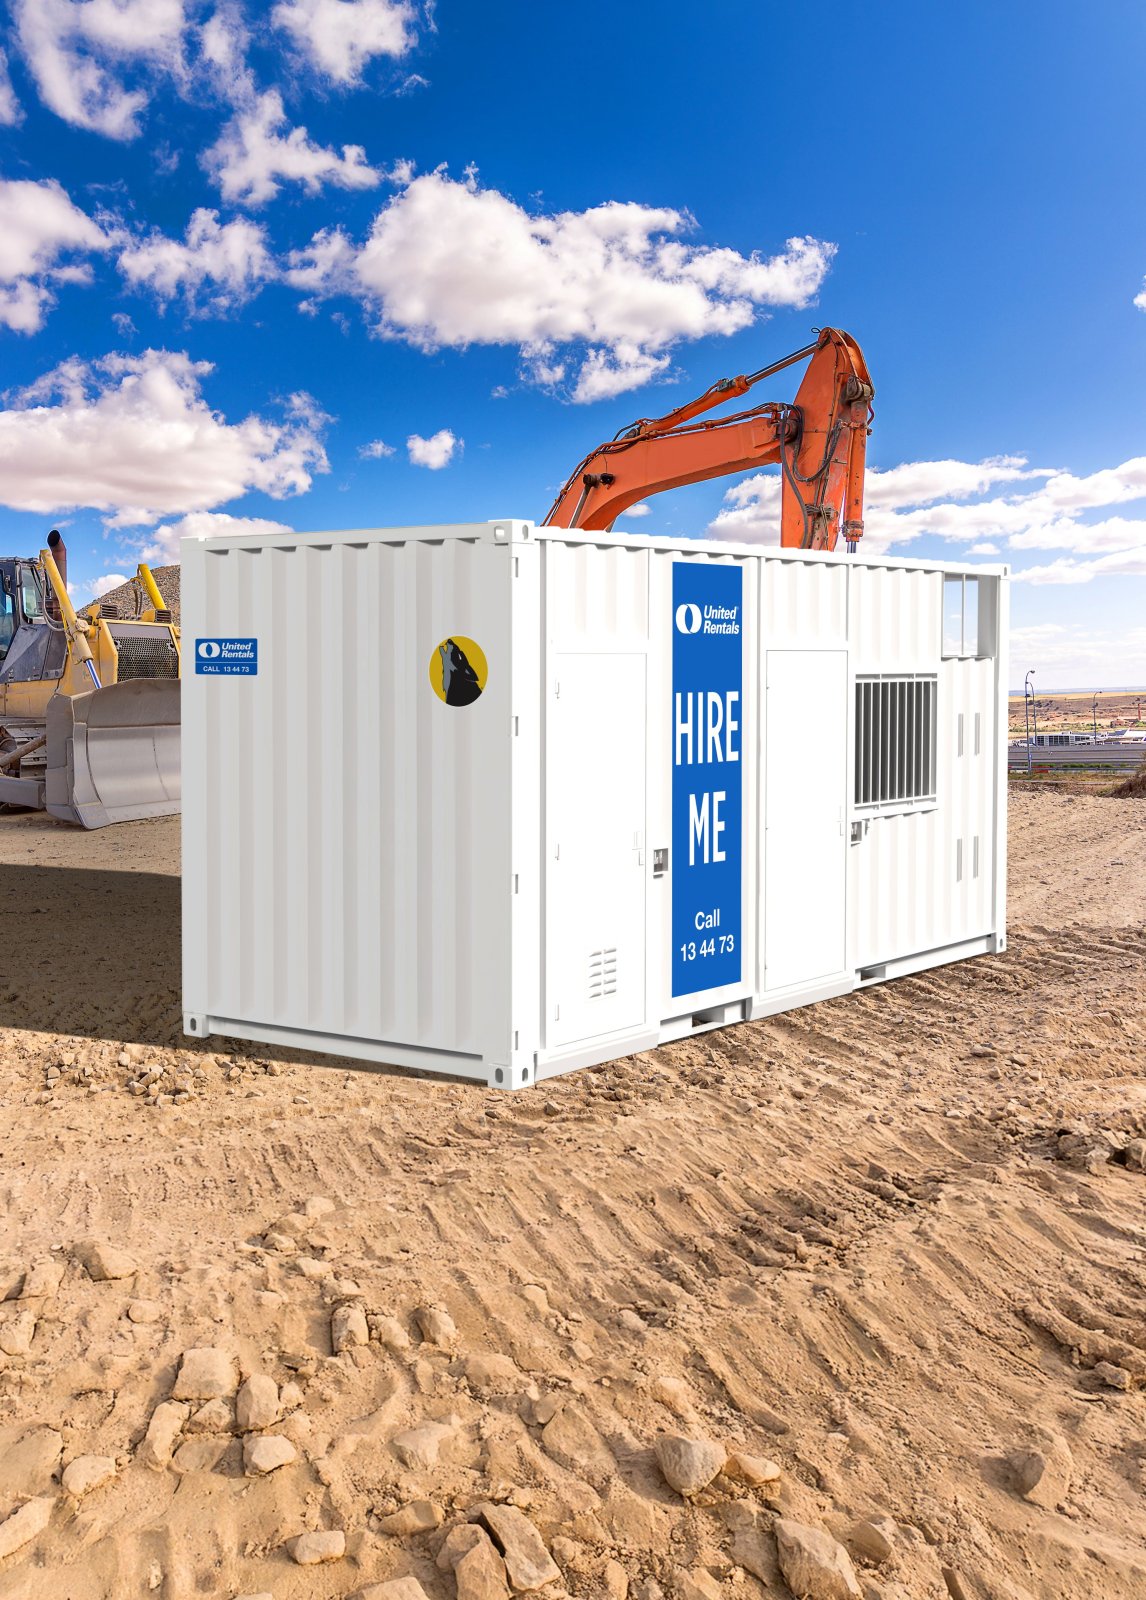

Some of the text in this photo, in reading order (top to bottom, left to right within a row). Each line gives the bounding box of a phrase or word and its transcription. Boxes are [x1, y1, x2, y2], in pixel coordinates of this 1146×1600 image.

[704, 605, 737, 620] United
[703, 620, 740, 635] Rentals
[222, 642, 252, 650] United
[222, 650, 254, 658] Rentals
[675, 691, 739, 765] HIRE
[689, 790, 726, 866] ME
[694, 908, 721, 931] Call
[680, 934, 735, 962] 13 44 73
